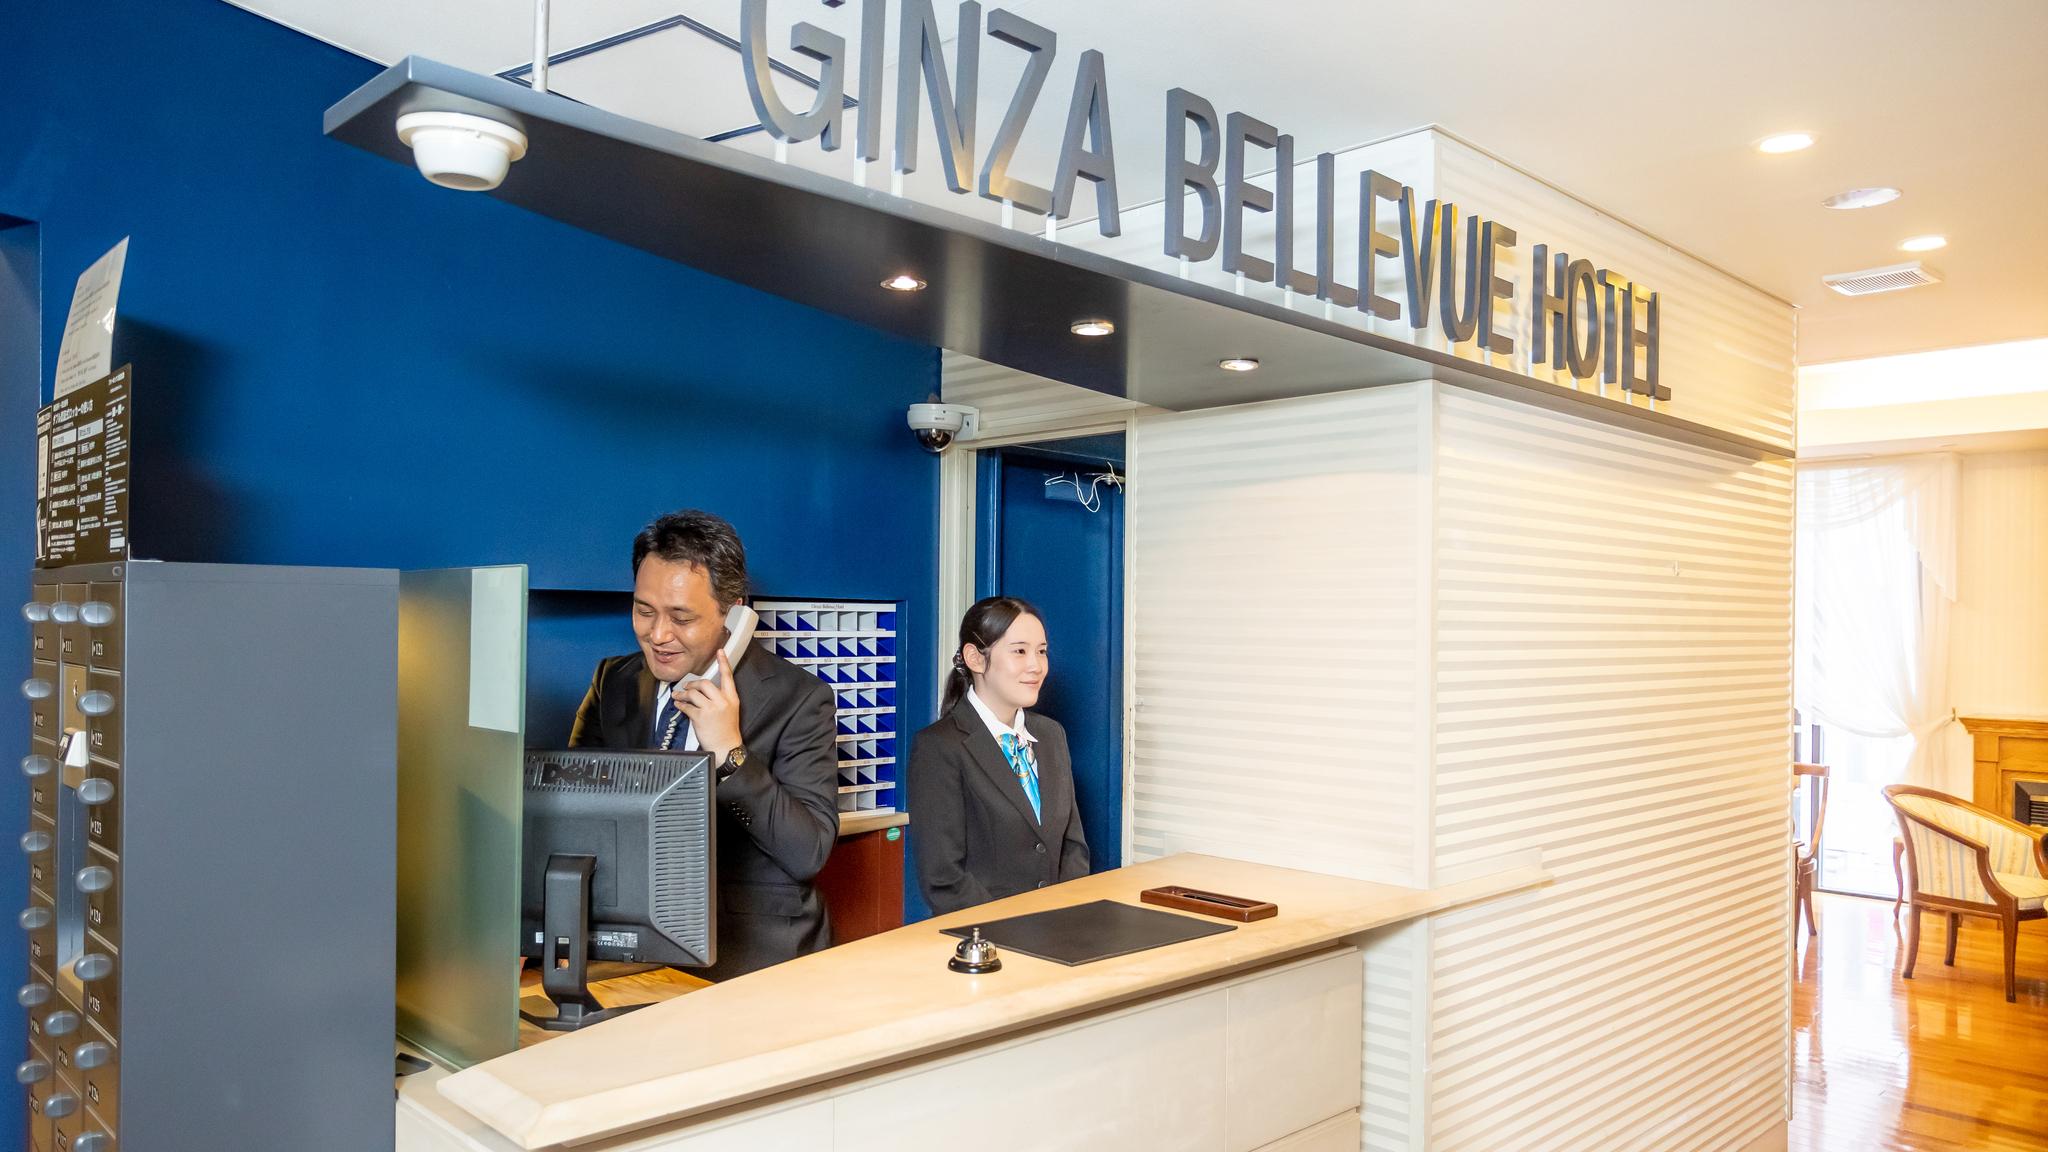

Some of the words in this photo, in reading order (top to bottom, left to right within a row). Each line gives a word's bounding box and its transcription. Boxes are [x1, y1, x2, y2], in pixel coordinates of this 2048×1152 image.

[740, 0, 1121, 238] GINZA
[1164, 87, 1517, 355] BELLEVUE
[1532, 244, 1672, 401] HOTEL
